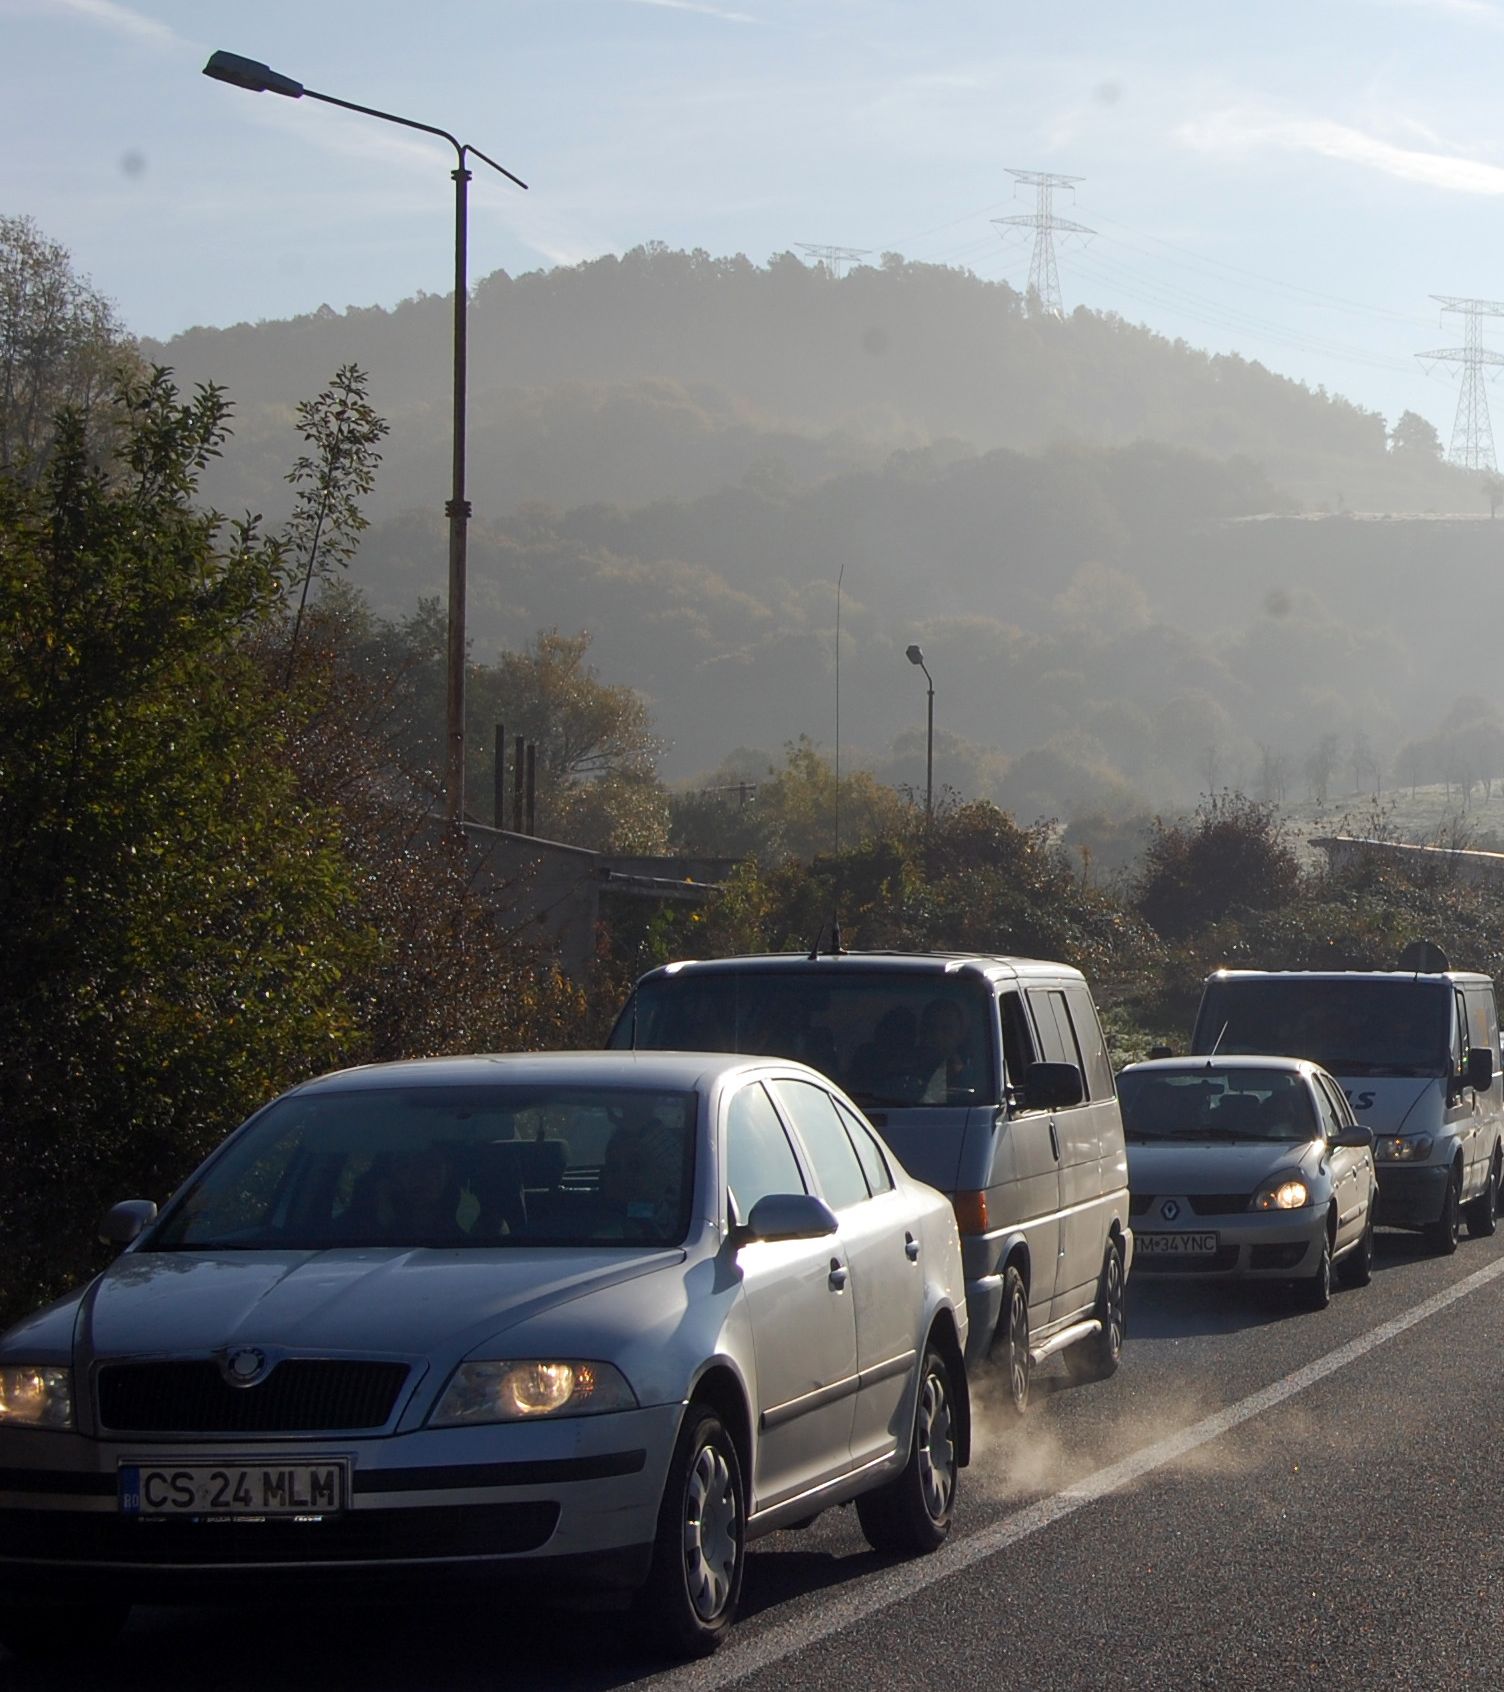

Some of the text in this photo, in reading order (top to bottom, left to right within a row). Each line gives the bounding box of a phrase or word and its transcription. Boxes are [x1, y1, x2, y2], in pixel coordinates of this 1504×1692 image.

[1181, 1235, 1215, 1251] YNC
[144, 1470, 335, 1508] CS 24 MLM
